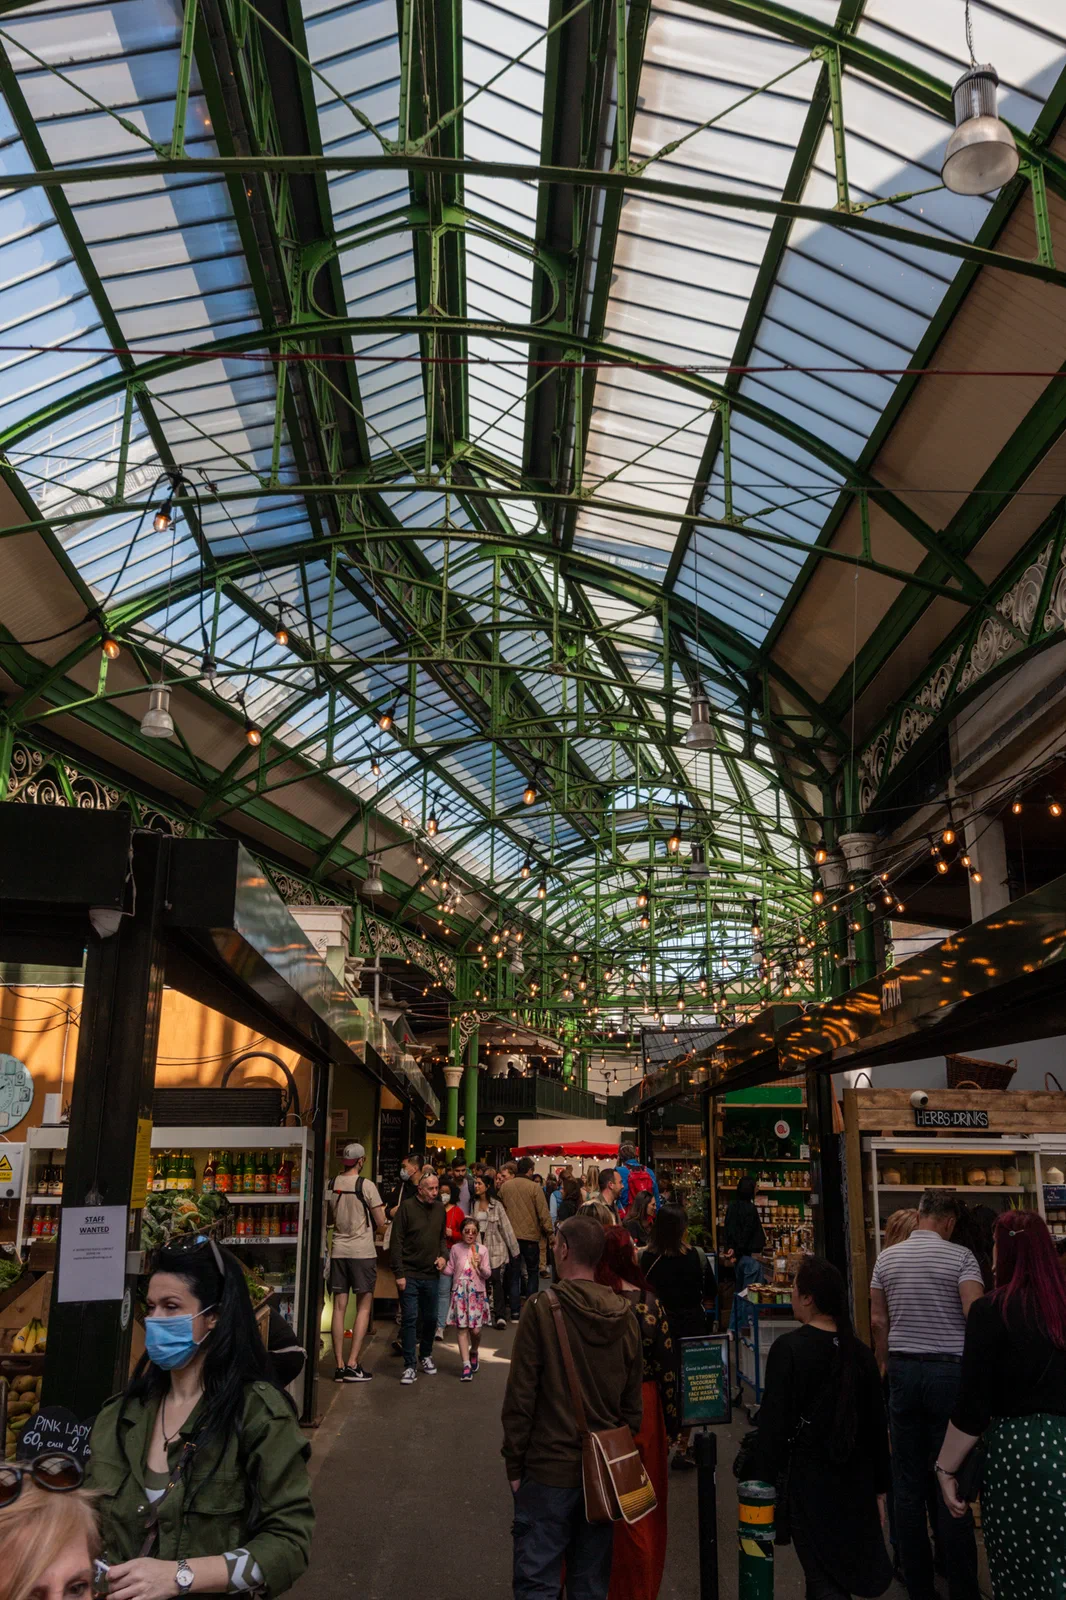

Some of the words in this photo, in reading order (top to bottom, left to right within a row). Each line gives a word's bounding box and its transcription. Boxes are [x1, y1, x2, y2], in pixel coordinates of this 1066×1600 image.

[917, 1110, 951, 1126] HERBS
[85, 1216, 104, 1224] STAFF
[33, 1415, 62, 1433] PINK
[65, 1422, 92, 1440] LADY
[22, 1430, 44, 1451] 60p
[67, 1436, 80, 1453] 2
